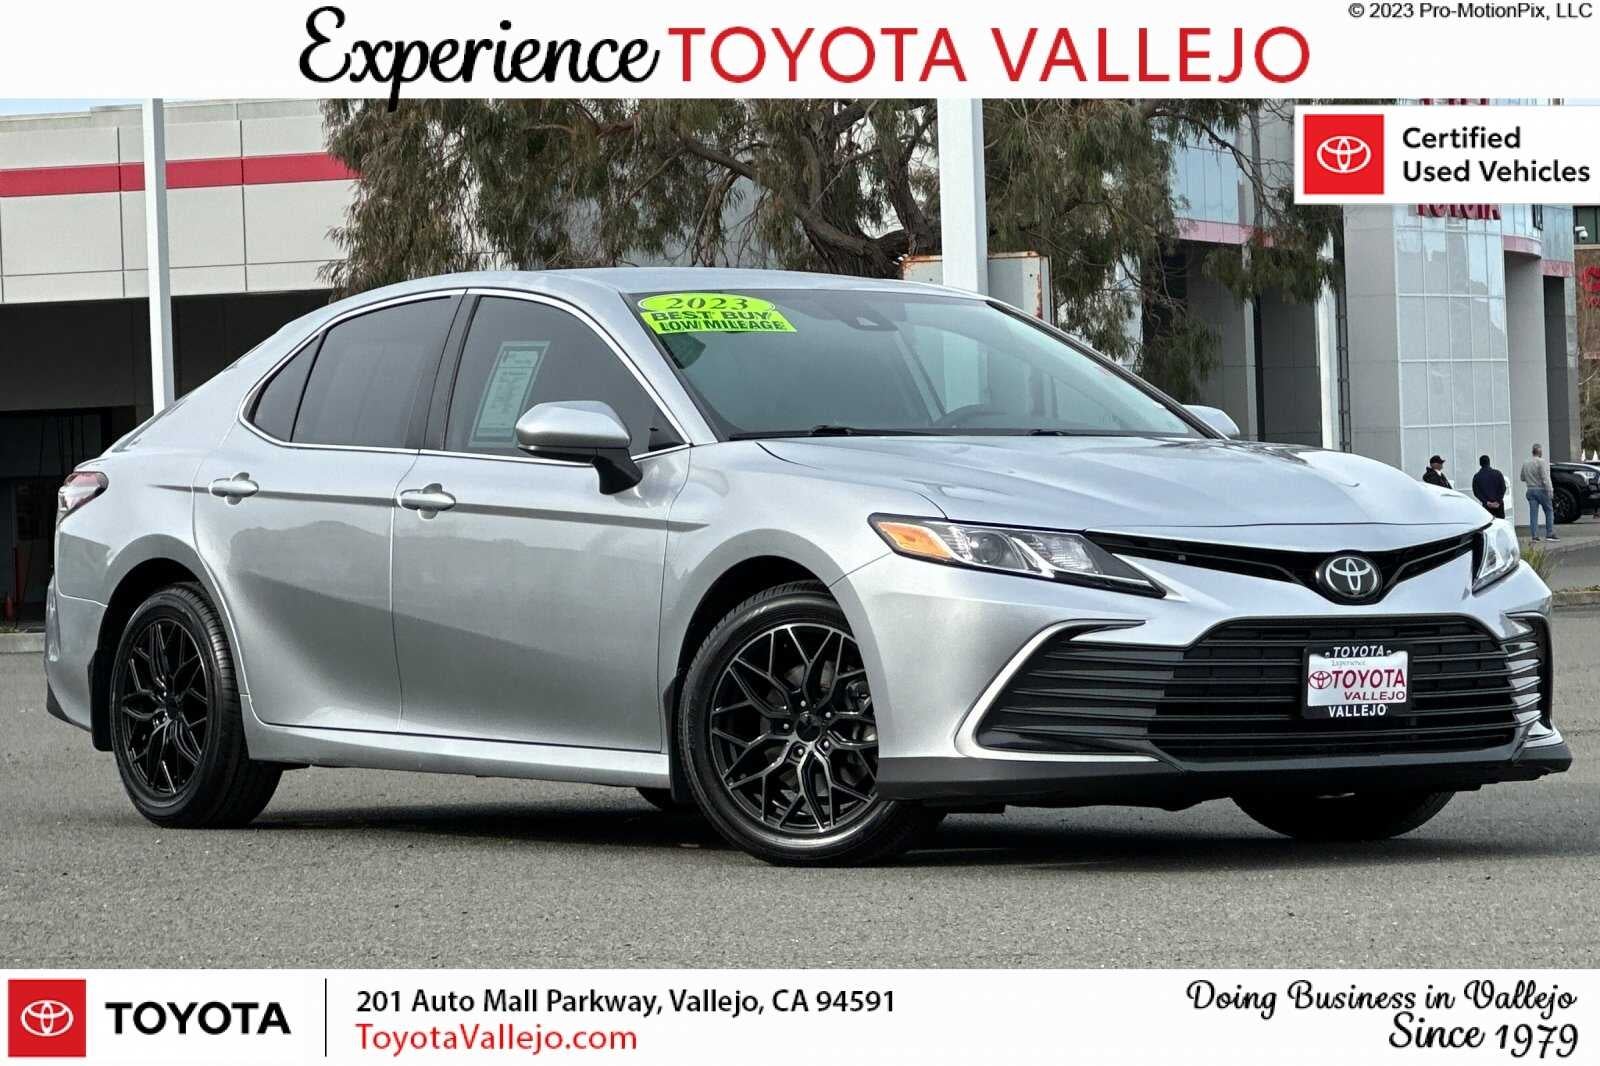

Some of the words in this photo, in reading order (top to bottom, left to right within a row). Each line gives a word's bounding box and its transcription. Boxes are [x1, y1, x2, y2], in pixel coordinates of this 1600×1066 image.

[665, 297, 749, 310] 2023
[652, 311, 717, 321] BEST
[721, 311, 772, 320] BUY
[659, 320, 701, 331] LOW
[703, 319, 785, 331] MILEAGE
[1333, 645, 1384, 658] TOYOTA
[1331, 668, 1406, 689] TOYOTA
[1344, 691, 1406, 701] VALLEJO
[1328, 704, 1387, 718] VALLEJO
